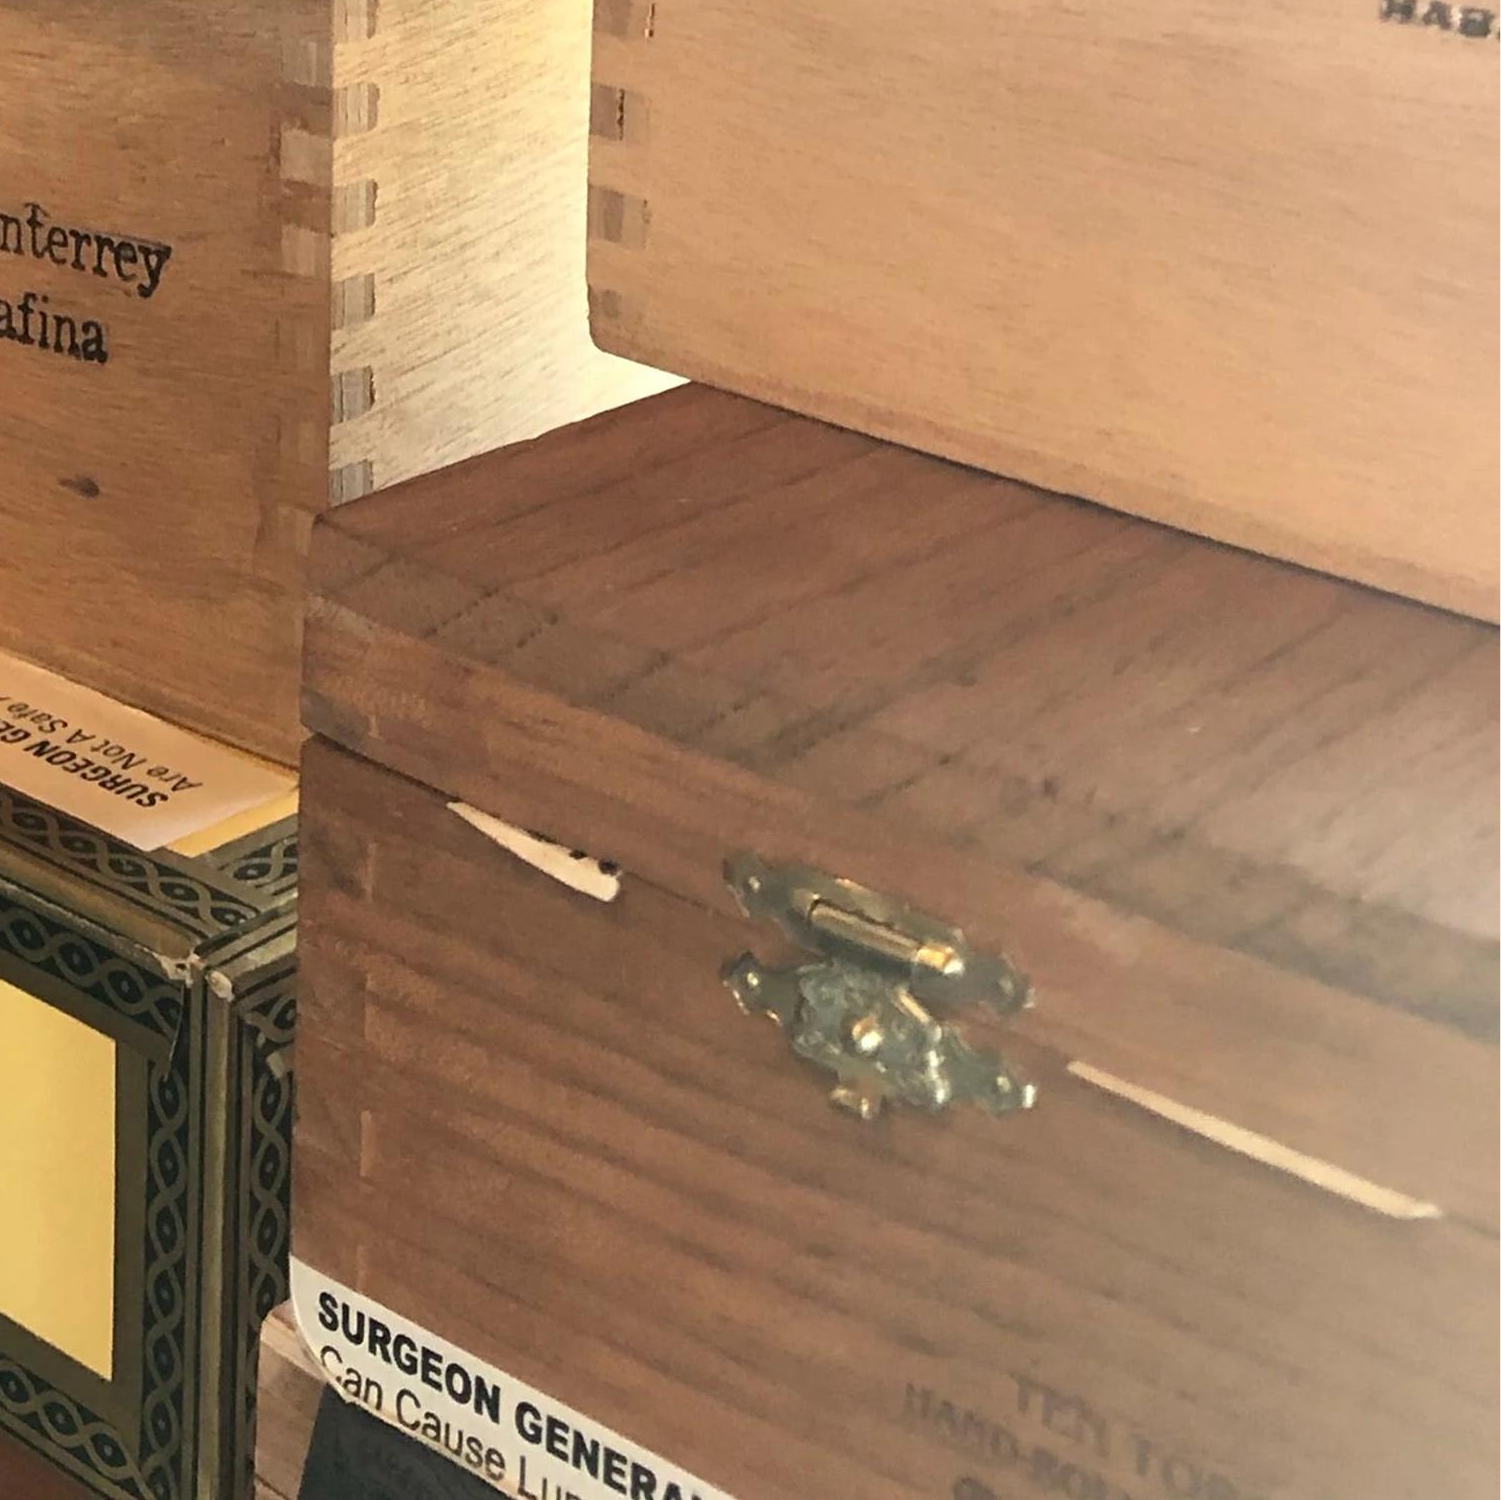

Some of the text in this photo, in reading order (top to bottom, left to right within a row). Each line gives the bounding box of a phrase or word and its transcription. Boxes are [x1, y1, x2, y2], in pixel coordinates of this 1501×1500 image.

[7, 701, 68, 735] Safe
[66, 728, 96, 745] A
[88, 738, 148, 772] Not
[21, 738, 170, 809] SURGEON
[145, 765, 204, 793] Are
[318, 1291, 501, 1425] SURGEON
[514, 1401, 704, 1500] GENER
[319, 1345, 384, 1413] Can
[395, 1388, 507, 1481] Cause
